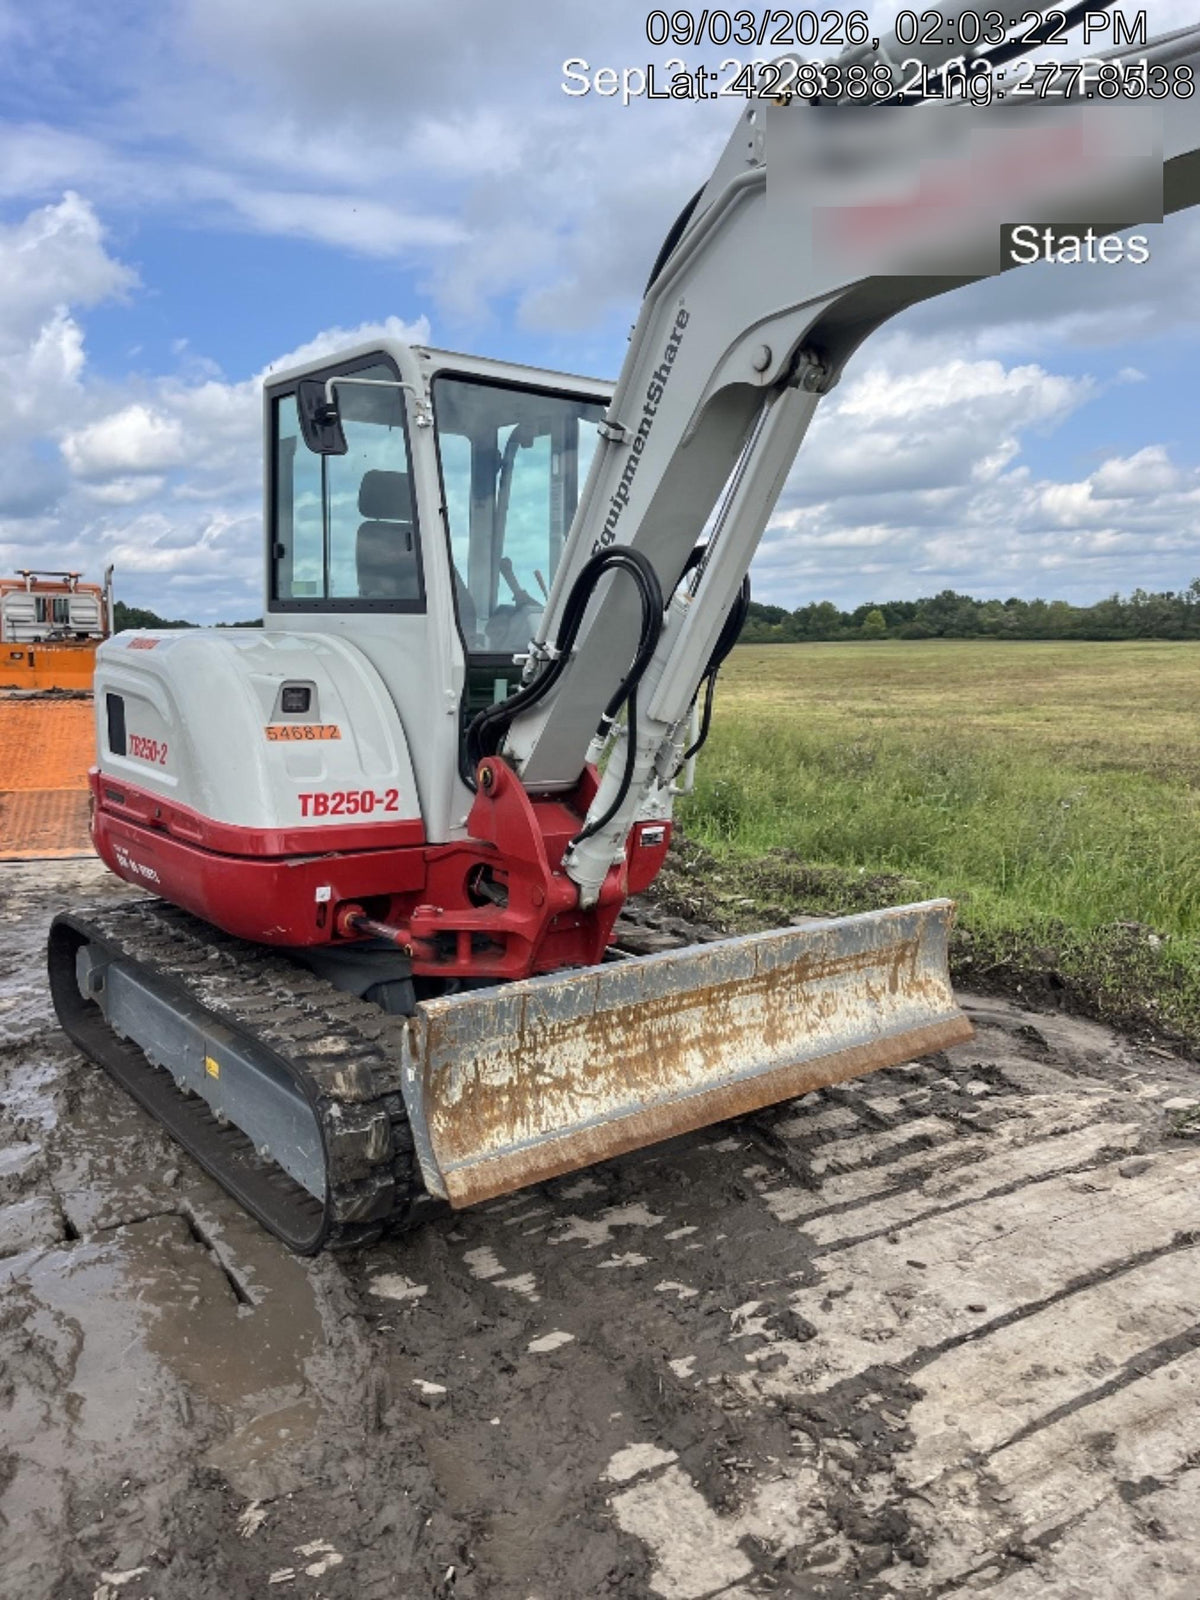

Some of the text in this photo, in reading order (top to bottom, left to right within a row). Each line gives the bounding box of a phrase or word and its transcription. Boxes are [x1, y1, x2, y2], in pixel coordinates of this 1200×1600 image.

[265, 725, 339, 741] 546872
[129, 734, 168, 766] TB250-2
[298, 788, 399, 817] TB250-2
